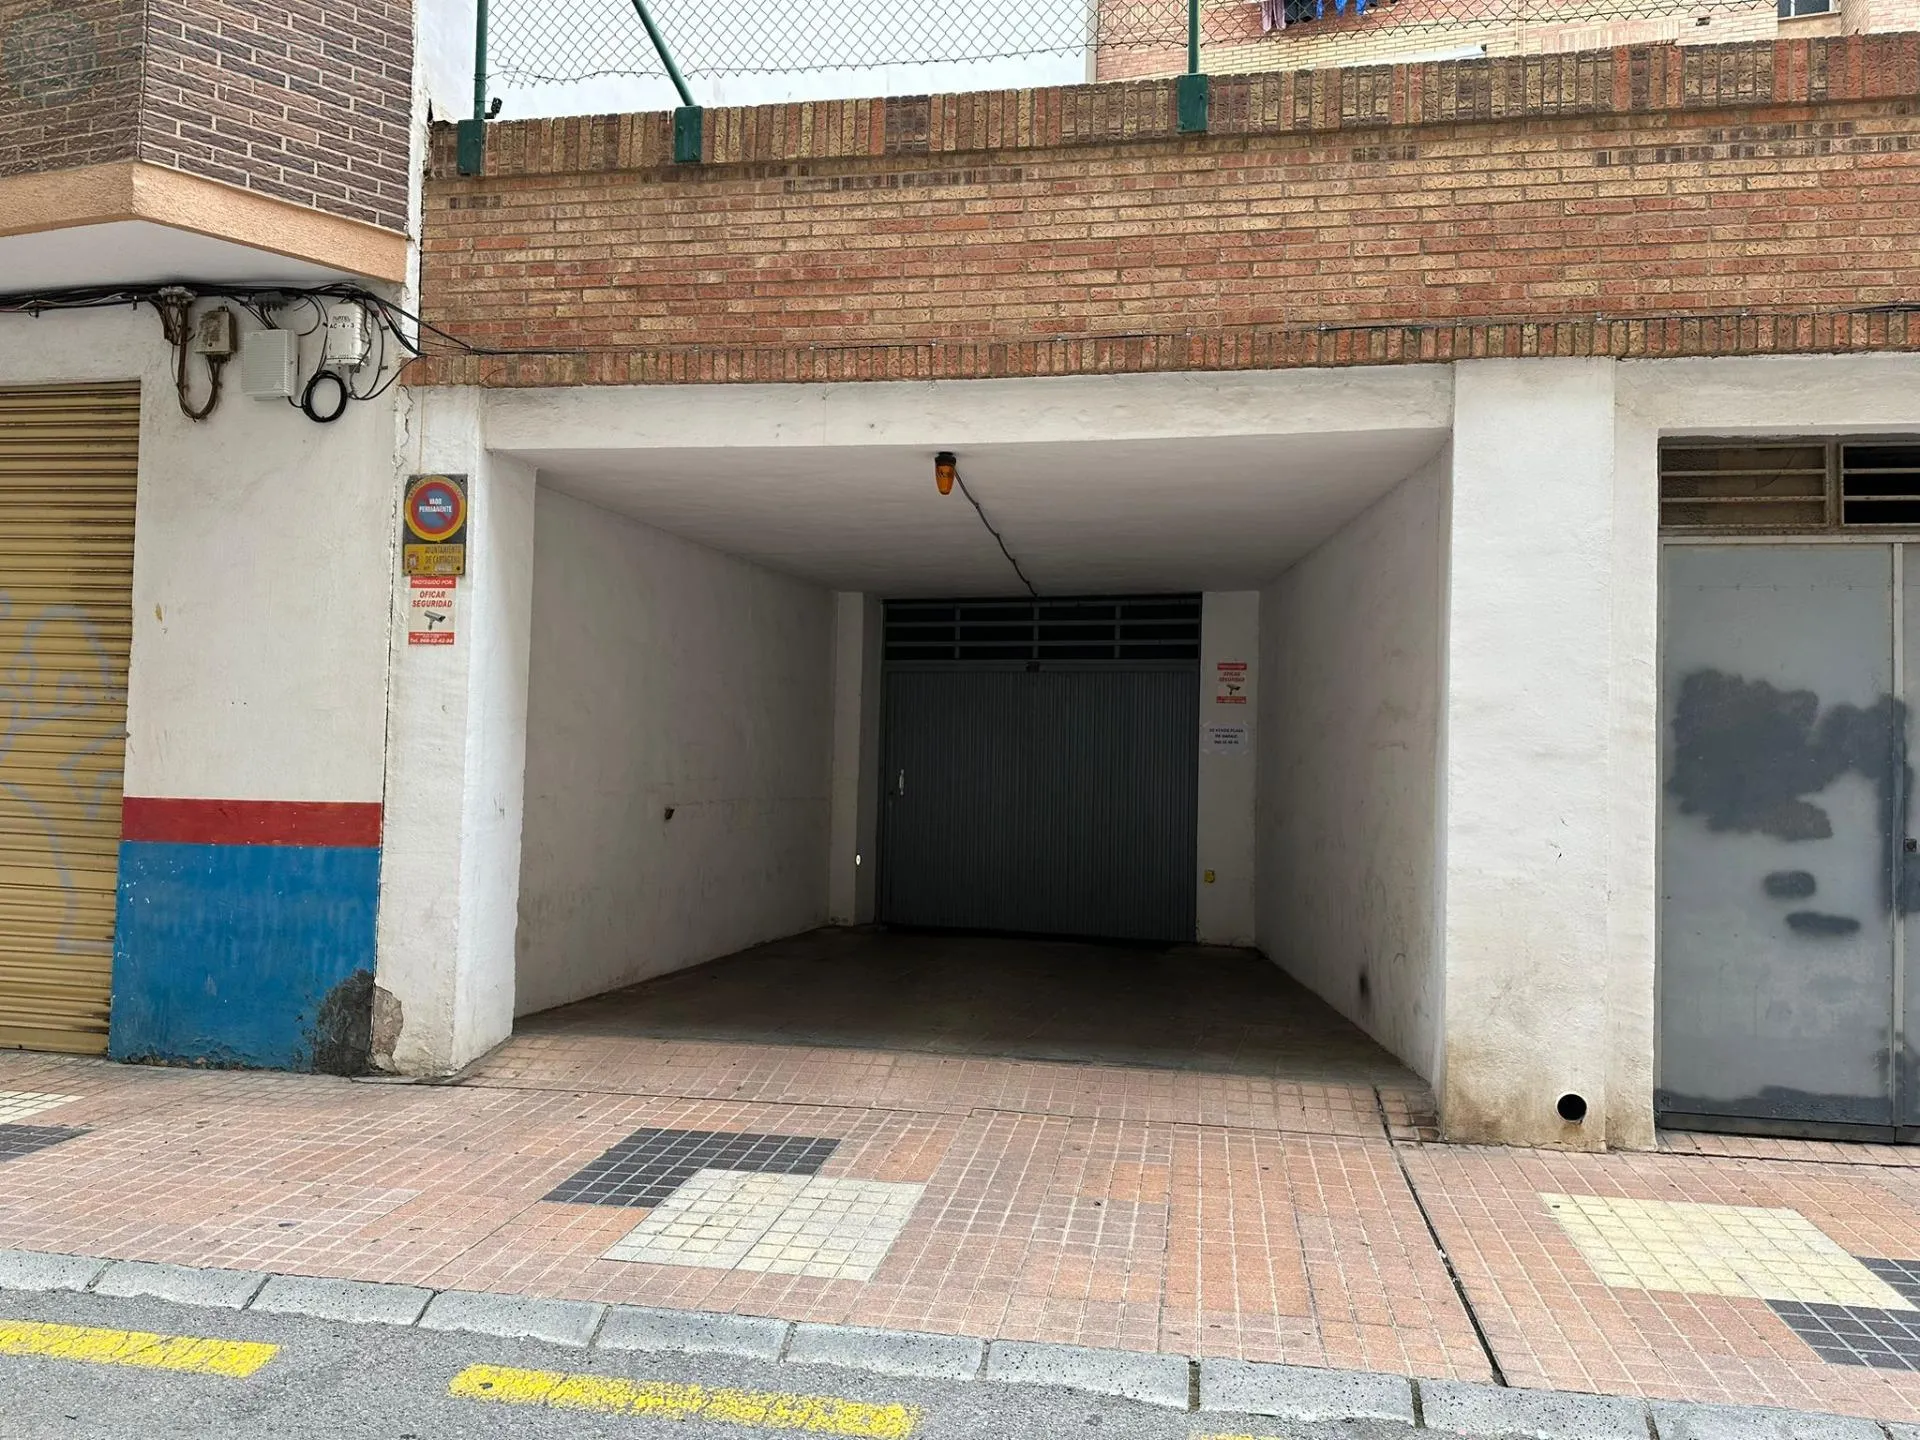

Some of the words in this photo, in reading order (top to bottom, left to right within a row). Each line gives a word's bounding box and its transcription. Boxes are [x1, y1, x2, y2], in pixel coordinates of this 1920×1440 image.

[419, 505, 452, 513] PERMANENTE
[424, 546, 463, 554] AYUNTAMIENTO
[420, 590, 446, 598] OFICAR
[412, 600, 453, 608] SEGURIDAD
